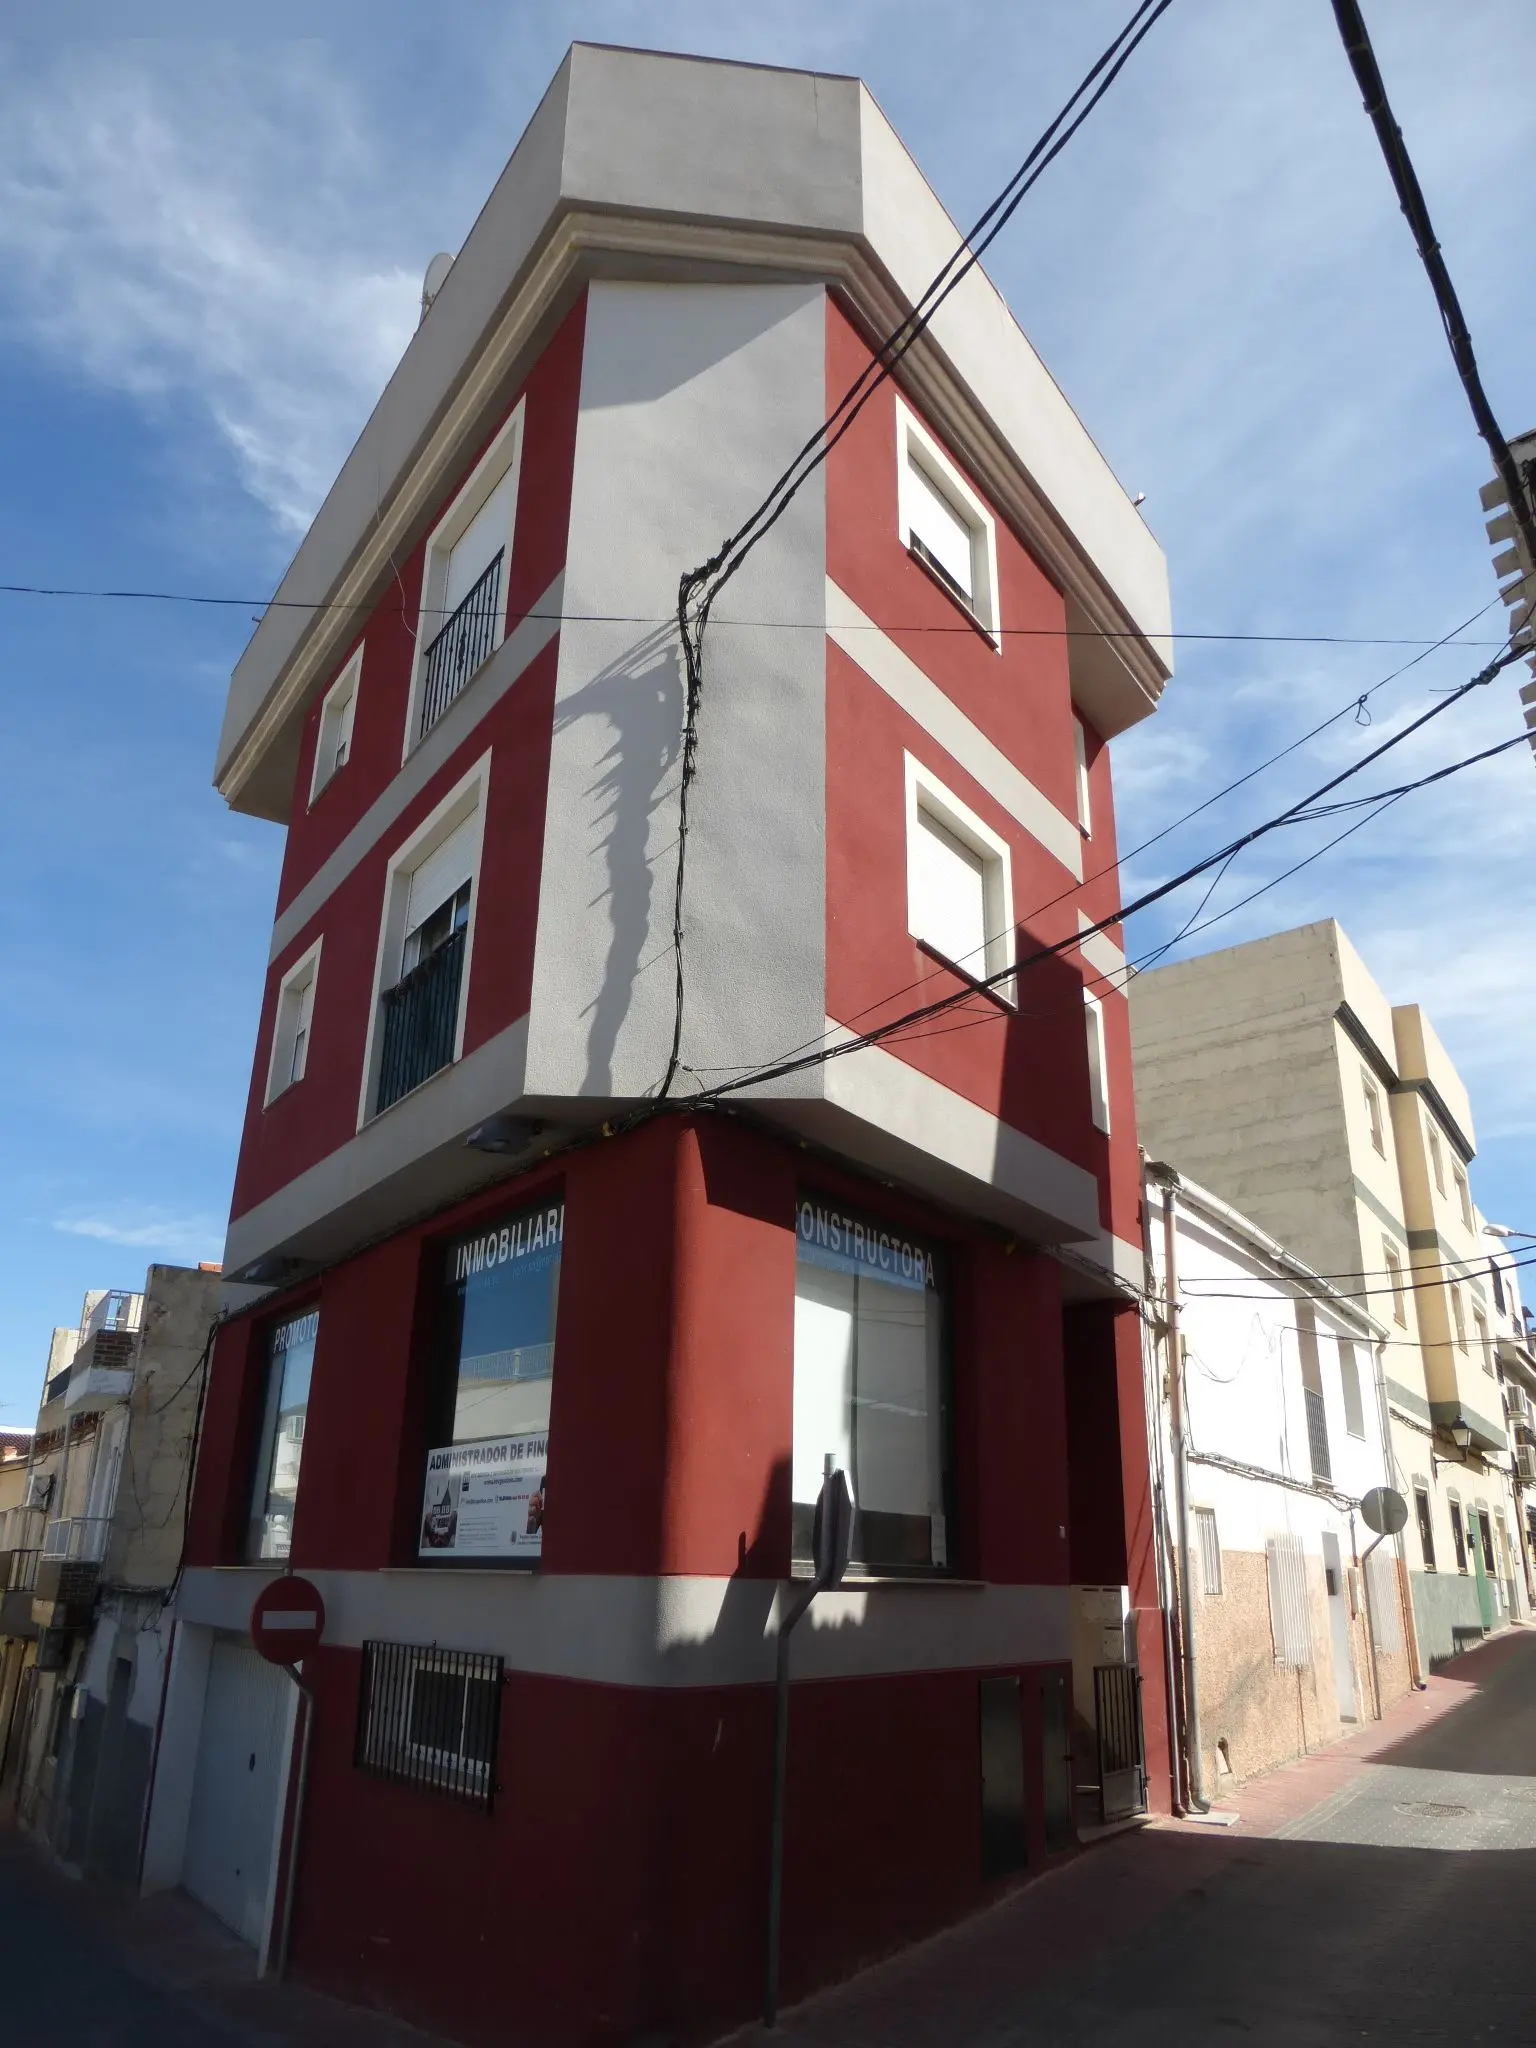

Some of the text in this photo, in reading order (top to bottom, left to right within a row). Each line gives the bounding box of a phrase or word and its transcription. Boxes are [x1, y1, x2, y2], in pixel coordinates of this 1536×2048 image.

[796, 1201, 935, 1287] ONSTRUCTORA
[429, 1445, 508, 1471] ADMINISTRADOR
[510, 1442, 525, 1460] DE
